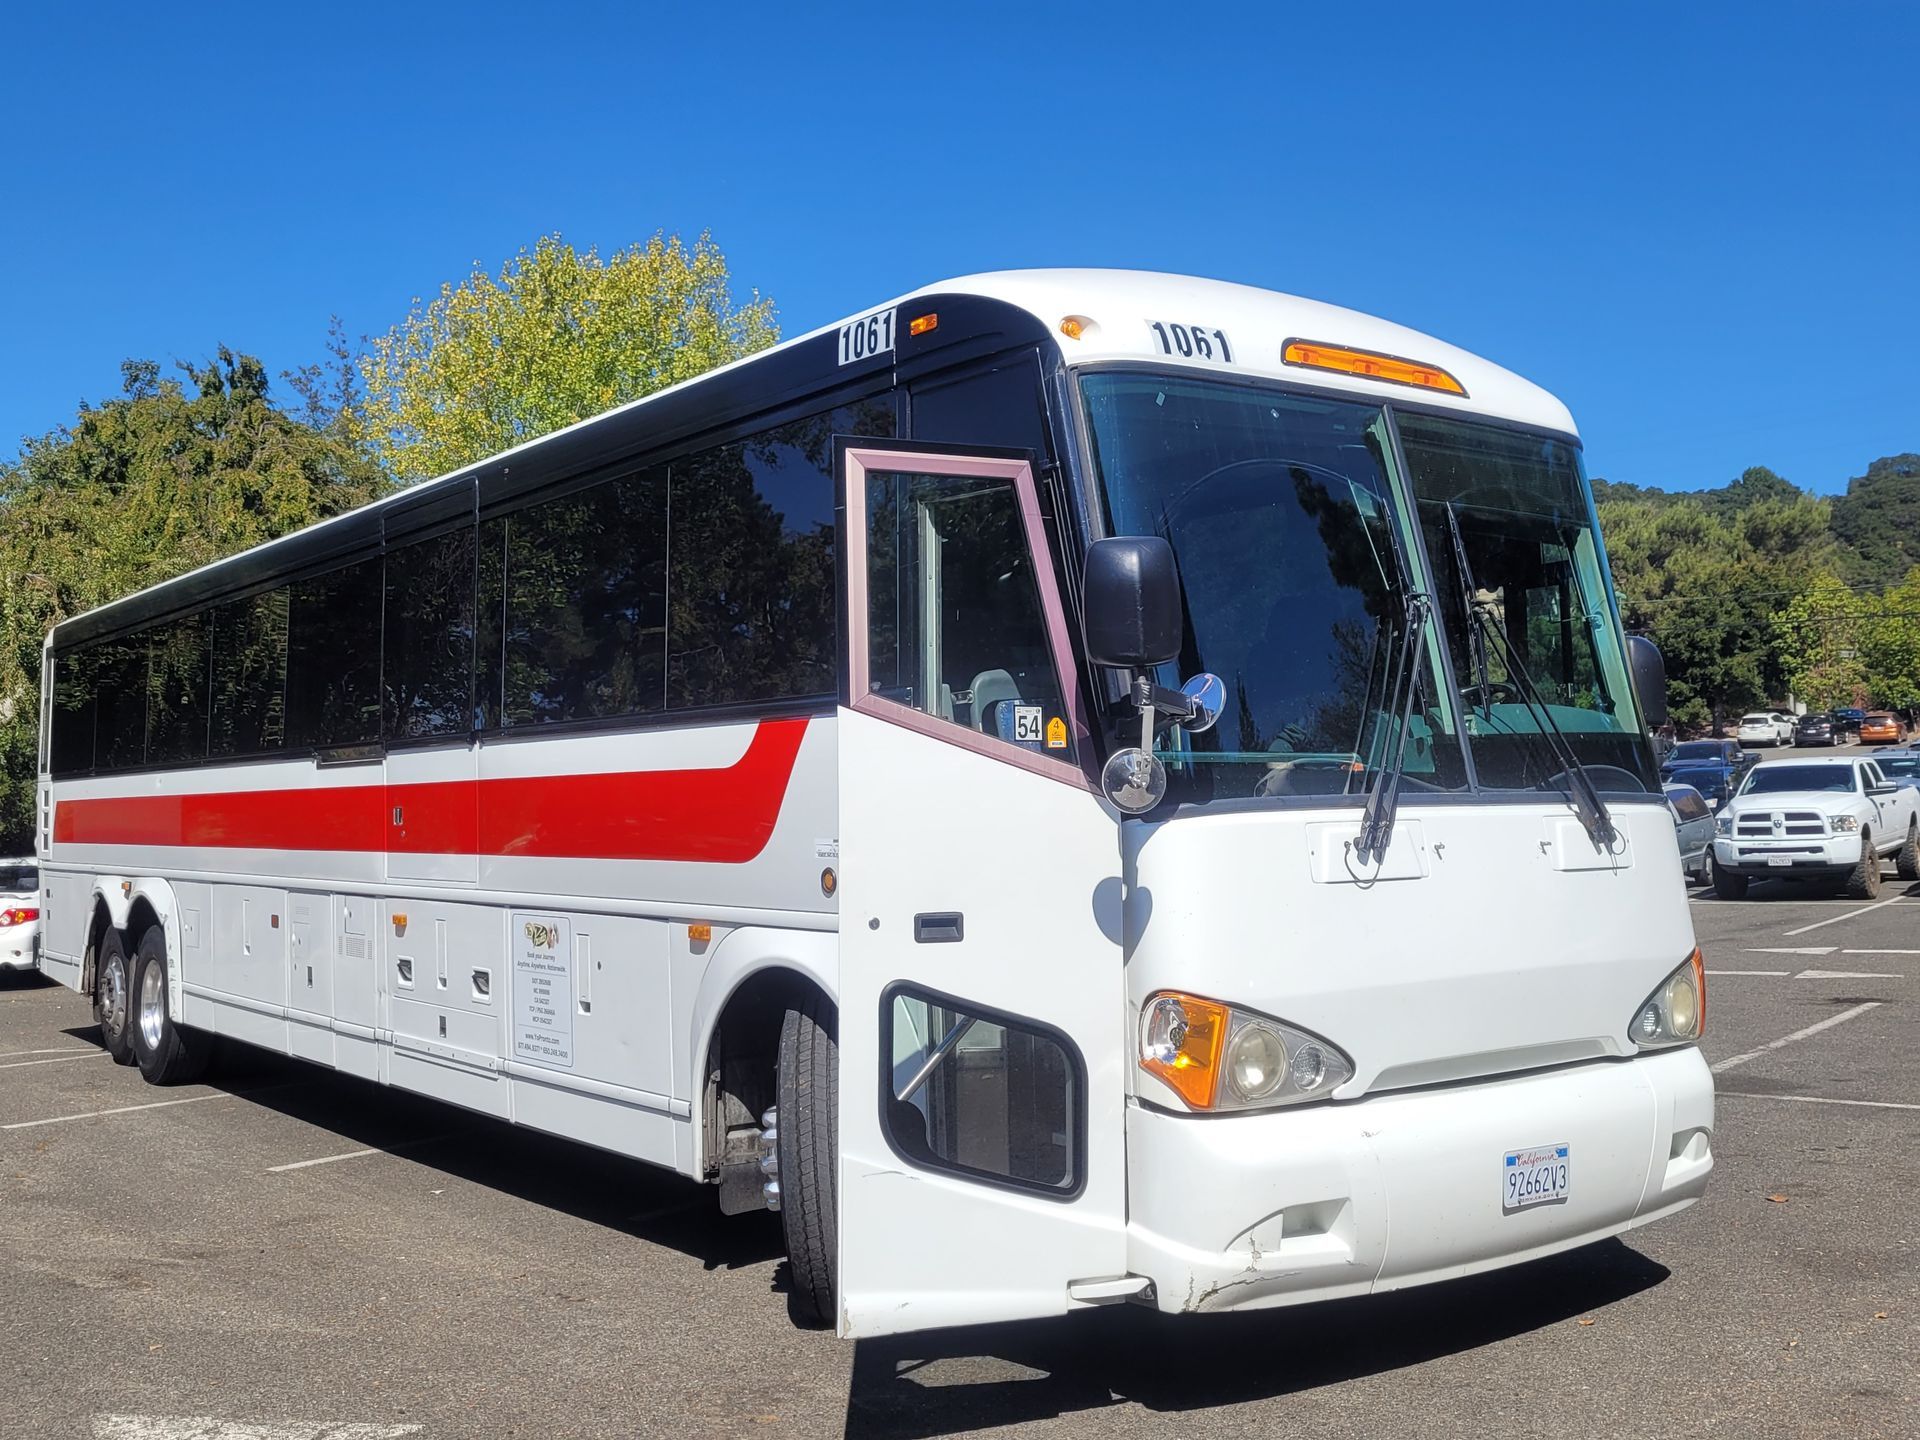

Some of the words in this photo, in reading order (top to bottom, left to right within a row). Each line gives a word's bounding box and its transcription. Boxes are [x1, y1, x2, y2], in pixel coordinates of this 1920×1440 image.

[842, 311, 894, 363] 1061
[1152, 321, 1231, 363] 1061
[1018, 715, 1040, 739] 54
[1517, 1151, 1558, 1169] California
[1509, 1164, 1566, 1199] 92662V3
